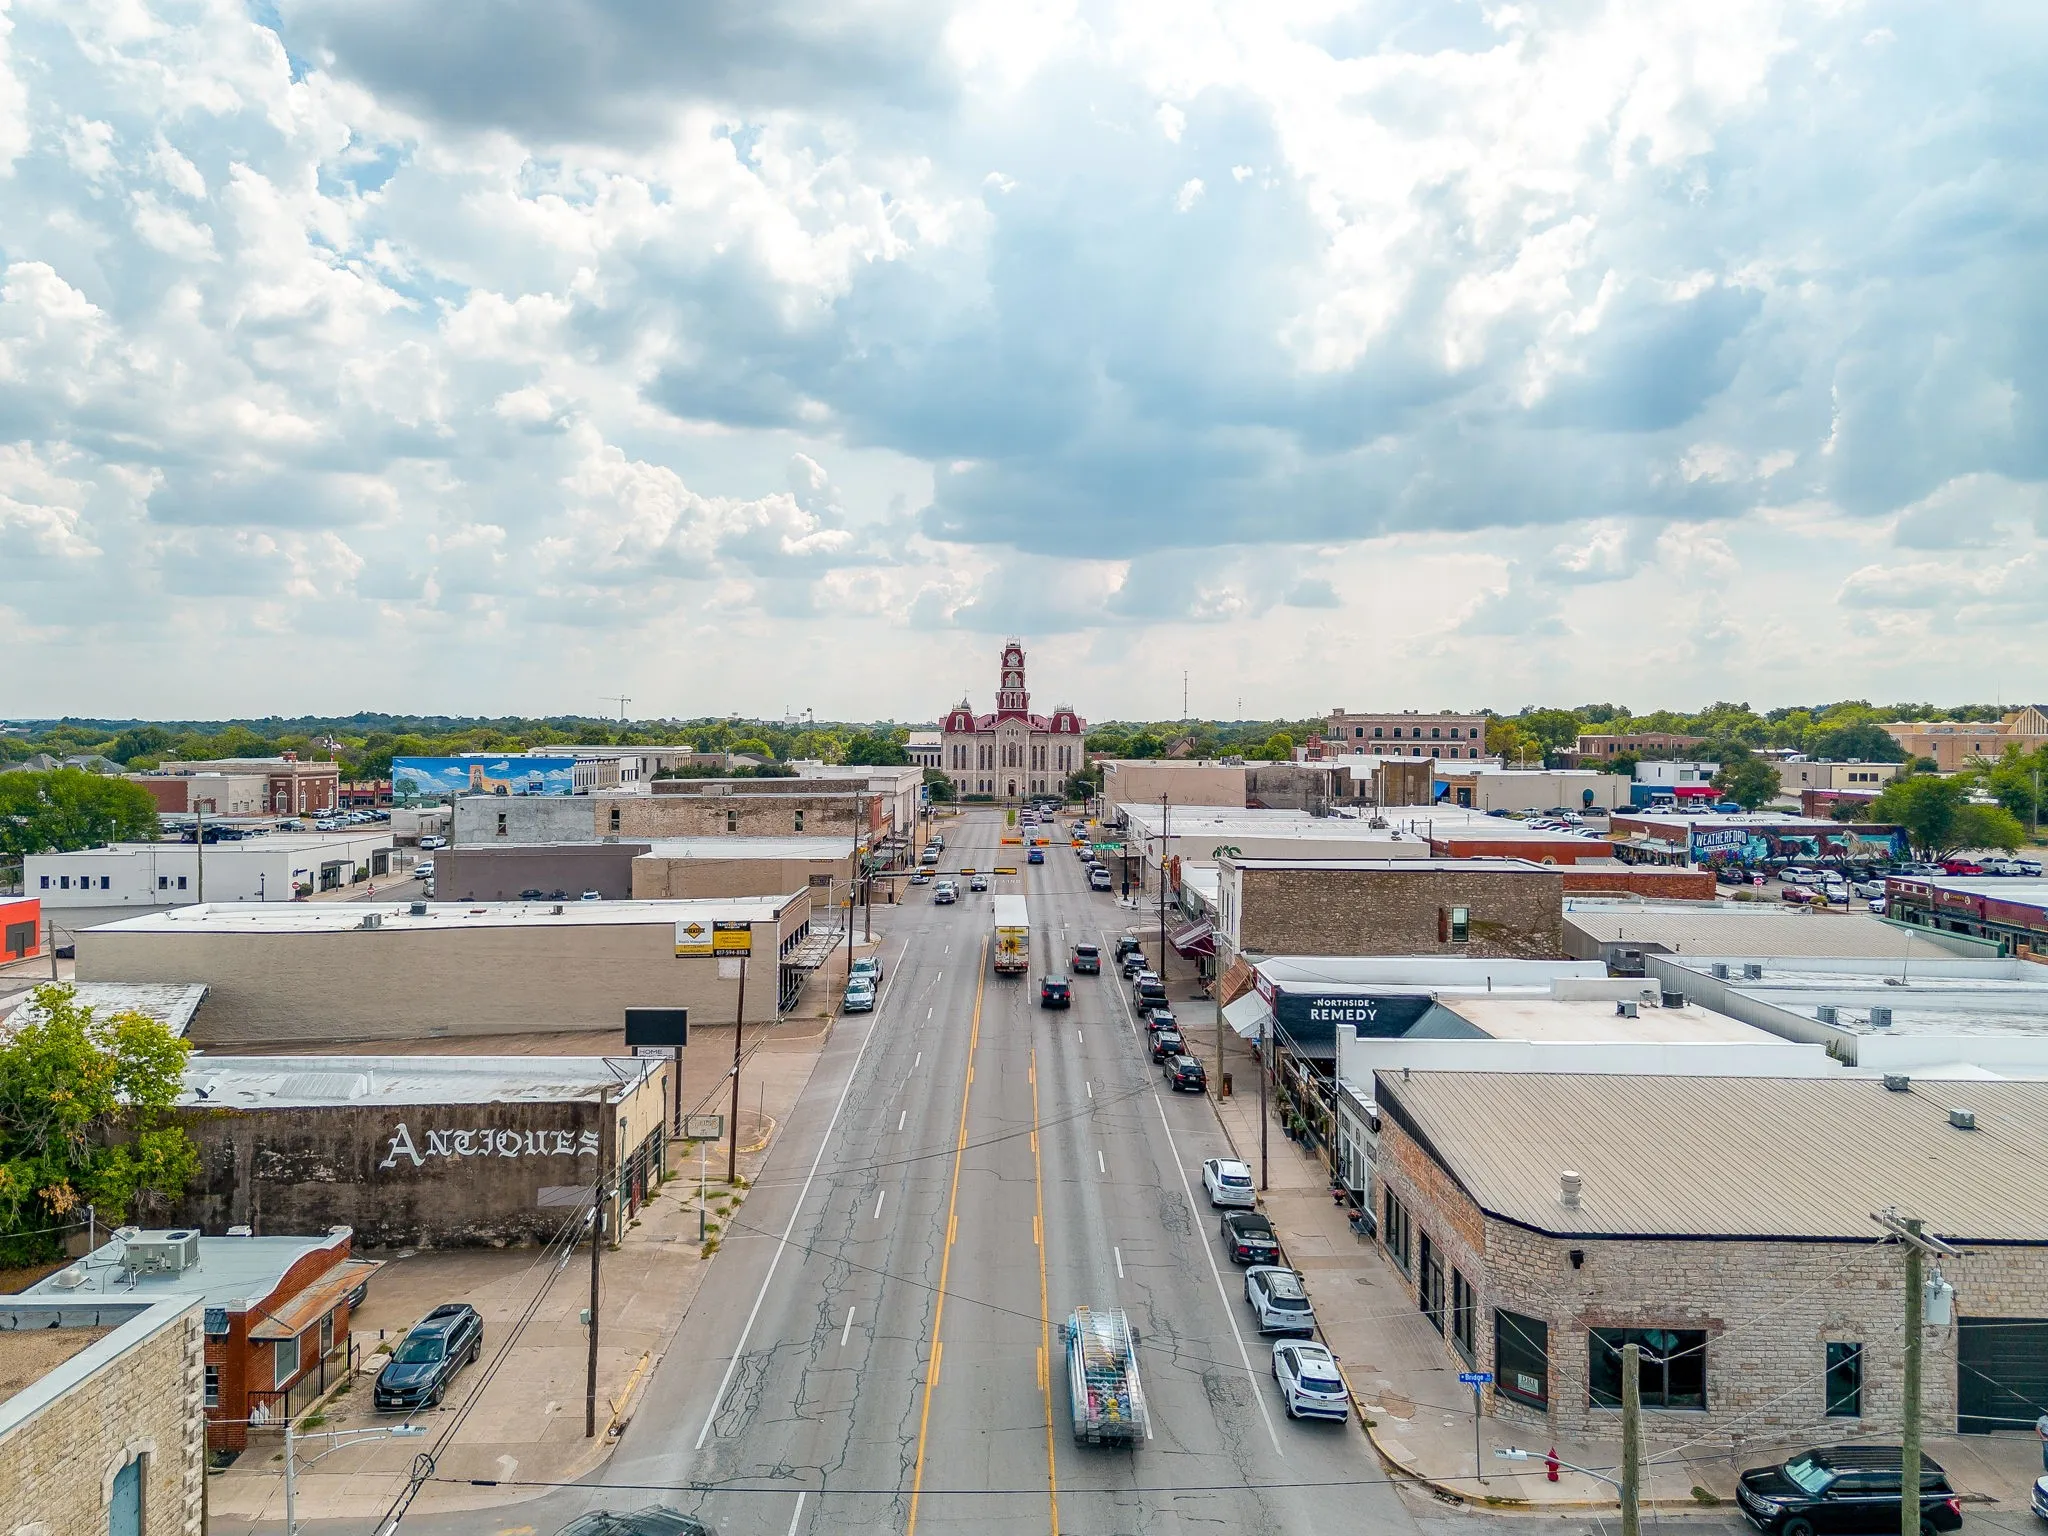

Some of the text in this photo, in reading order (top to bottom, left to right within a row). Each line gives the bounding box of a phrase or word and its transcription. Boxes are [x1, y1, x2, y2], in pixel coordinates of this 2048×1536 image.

[1696, 829, 1747, 847] WEATHERFORD
[1317, 998, 1370, 1007] NORTHSIDE
[1310, 1008, 1377, 1021] REMEDY
[379, 1123, 599, 1169] ANTIQUES
[1465, 1373, 1484, 1381] Bridge
